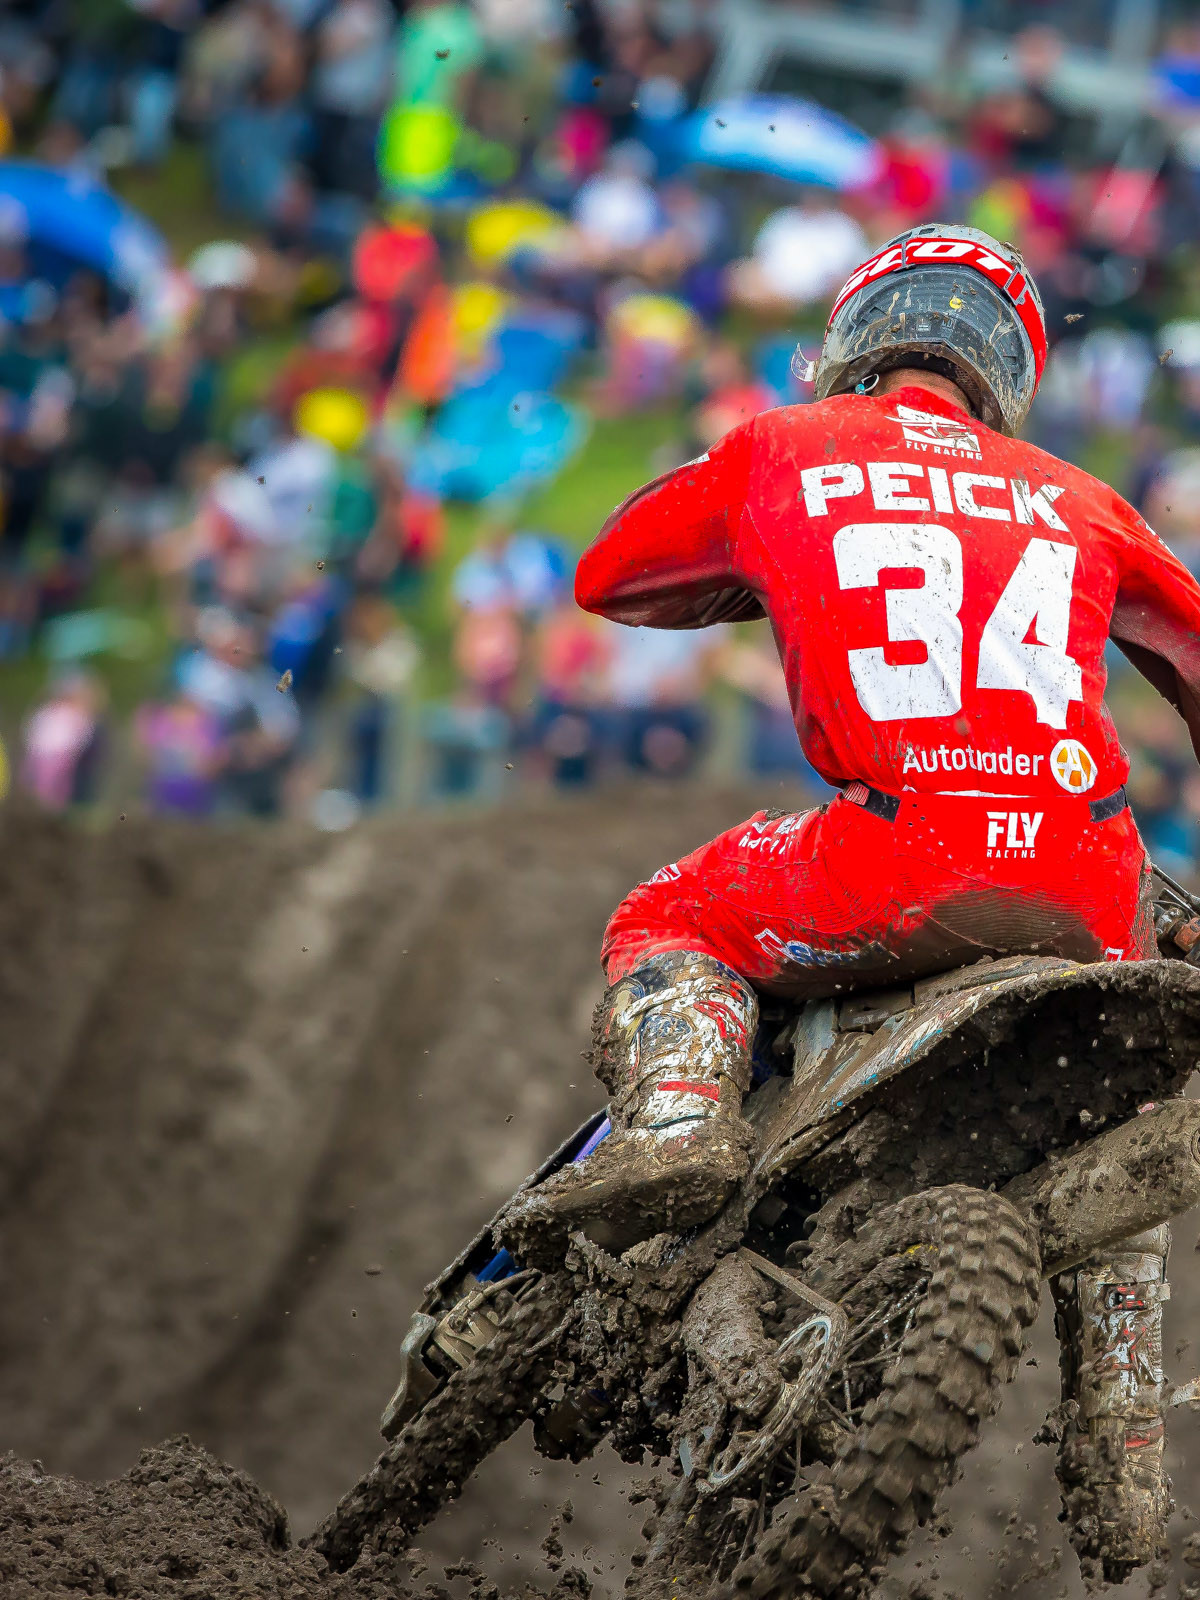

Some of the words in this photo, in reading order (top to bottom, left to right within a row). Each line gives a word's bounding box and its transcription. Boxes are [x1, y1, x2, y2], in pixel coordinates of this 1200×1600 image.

[905, 440, 928, 452] FLY
[933, 445, 983, 461] RACING
[800, 462, 1070, 532] PEICK
[832, 522, 1084, 730] 34
[986, 811, 1045, 848] FLY
[986, 849, 1036, 859] RACING
